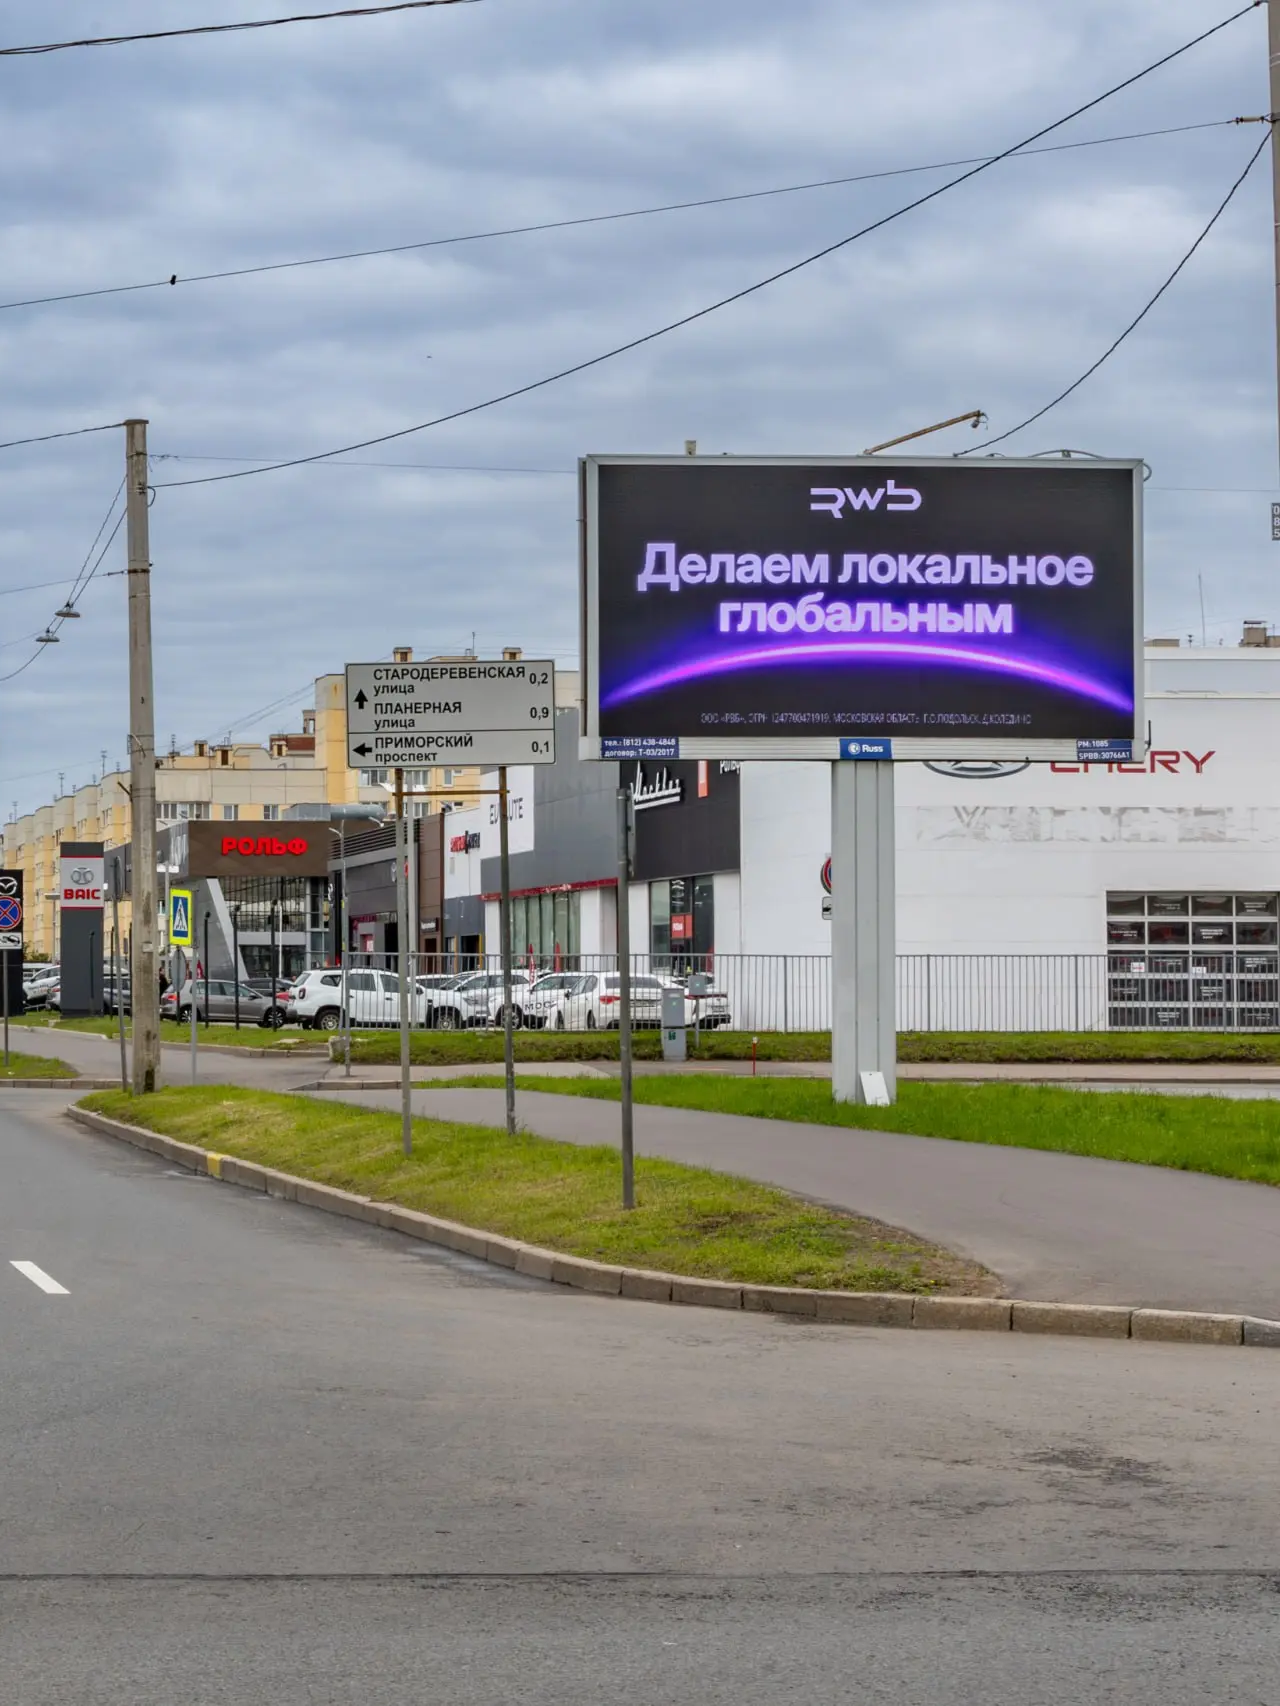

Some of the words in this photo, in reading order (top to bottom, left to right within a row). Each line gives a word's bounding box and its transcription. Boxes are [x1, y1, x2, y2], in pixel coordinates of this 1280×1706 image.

[636, 543, 829, 592] Делаем
[837, 553, 1095, 586] локальное
[719, 591, 1013, 634] глобальным
[373, 666, 526, 681] СТАРОДЕРЕВЕНСКАЯ
[529, 672, 549, 687] 0,2
[373, 684, 415, 697] улица
[374, 701, 462, 715] ПЛАНЕРНАЯ
[529, 706, 549, 720] 0,9
[374, 717, 416, 731] улица
[375, 733, 473, 749] ПРИМОРСКИЙ
[531, 741, 550, 755] 0,1
[622, 738, 642, 747] (812)
[862, 744, 884, 753] Russ
[375, 751, 438, 765] проспект
[604, 749, 637, 758] договор:
[221, 837, 308, 856] РОЛЬФ
[63, 888, 101, 900] BAIC
